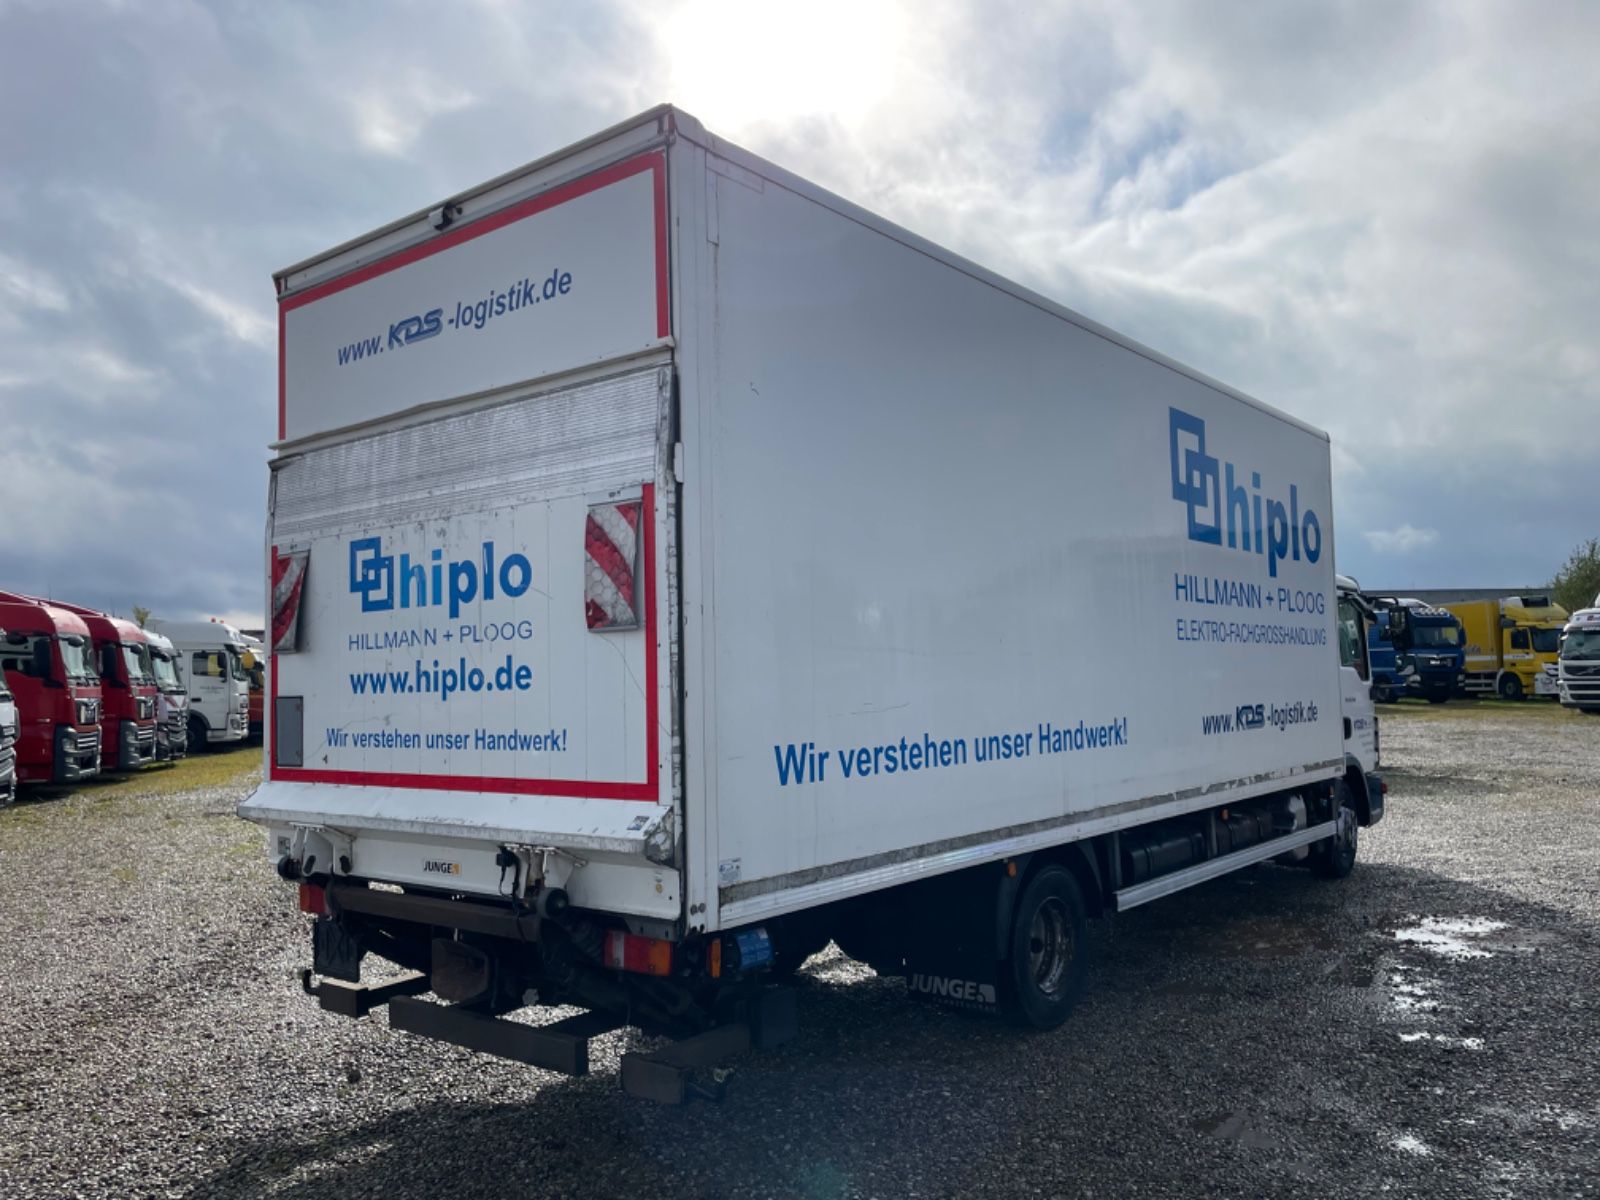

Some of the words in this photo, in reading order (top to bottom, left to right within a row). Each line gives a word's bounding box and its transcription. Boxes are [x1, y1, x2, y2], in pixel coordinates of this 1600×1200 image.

[1225, 461, 1321, 577] hiplo
[399, 541, 532, 619] hiplo
[1175, 573, 1261, 608] HILLMANN
[1266, 591, 1274, 605] +
[1278, 588, 1325, 614] PLOOG
[349, 628, 437, 651] HILLMANN
[443, 631, 453, 641] +
[460, 621, 533, 643] PLOOG
[1177, 619, 1326, 645] ELEKTRO-FACHGROSSHANDLUNG
[350, 655, 533, 701] www.hiplo.de
[326, 728, 348, 748] Wir
[351, 728, 421, 749] verstehen
[426, 733, 470, 750] unser
[474, 728, 567, 751] Handwerk!
[774, 742, 829, 786] Wir
[838, 733, 967, 779] verstehen
[975, 731, 1032, 763] unser
[1038, 716, 1128, 754] Handwerk!
[423, 861, 453, 874] JUNGE
[908, 973, 977, 1001] JUNGE
